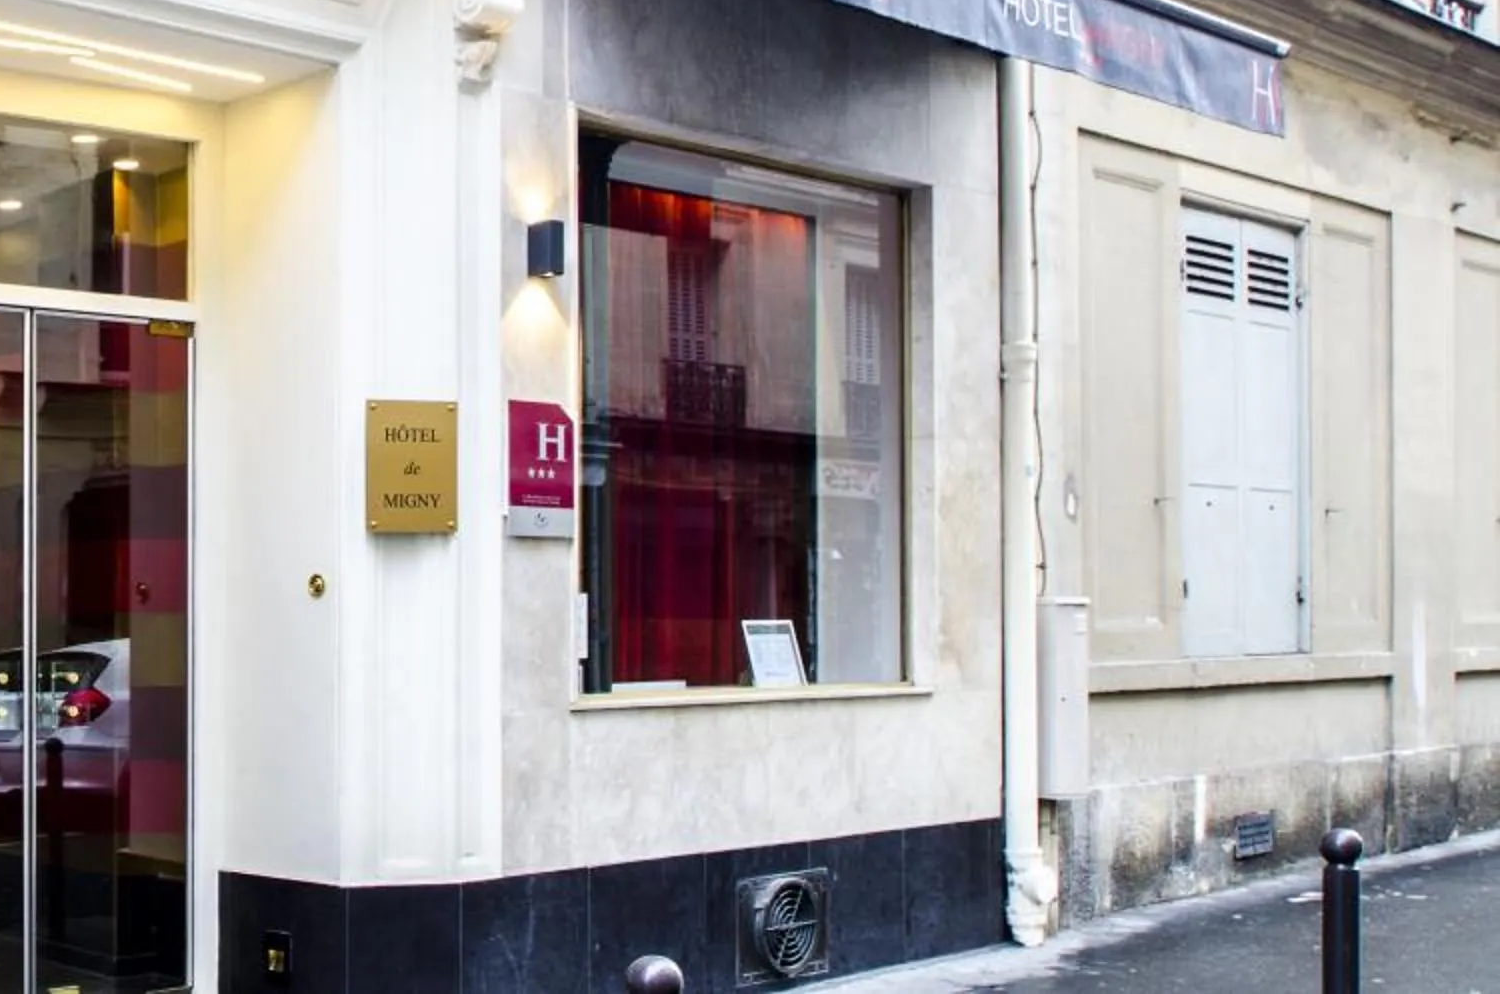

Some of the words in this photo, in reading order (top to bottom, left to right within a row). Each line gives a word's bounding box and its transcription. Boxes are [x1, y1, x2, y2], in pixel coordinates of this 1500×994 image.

[384, 423, 441, 444] HÔTEL
[536, 422, 567, 463] H
[403, 461, 421, 476] de
[383, 493, 442, 509] MIGNY
